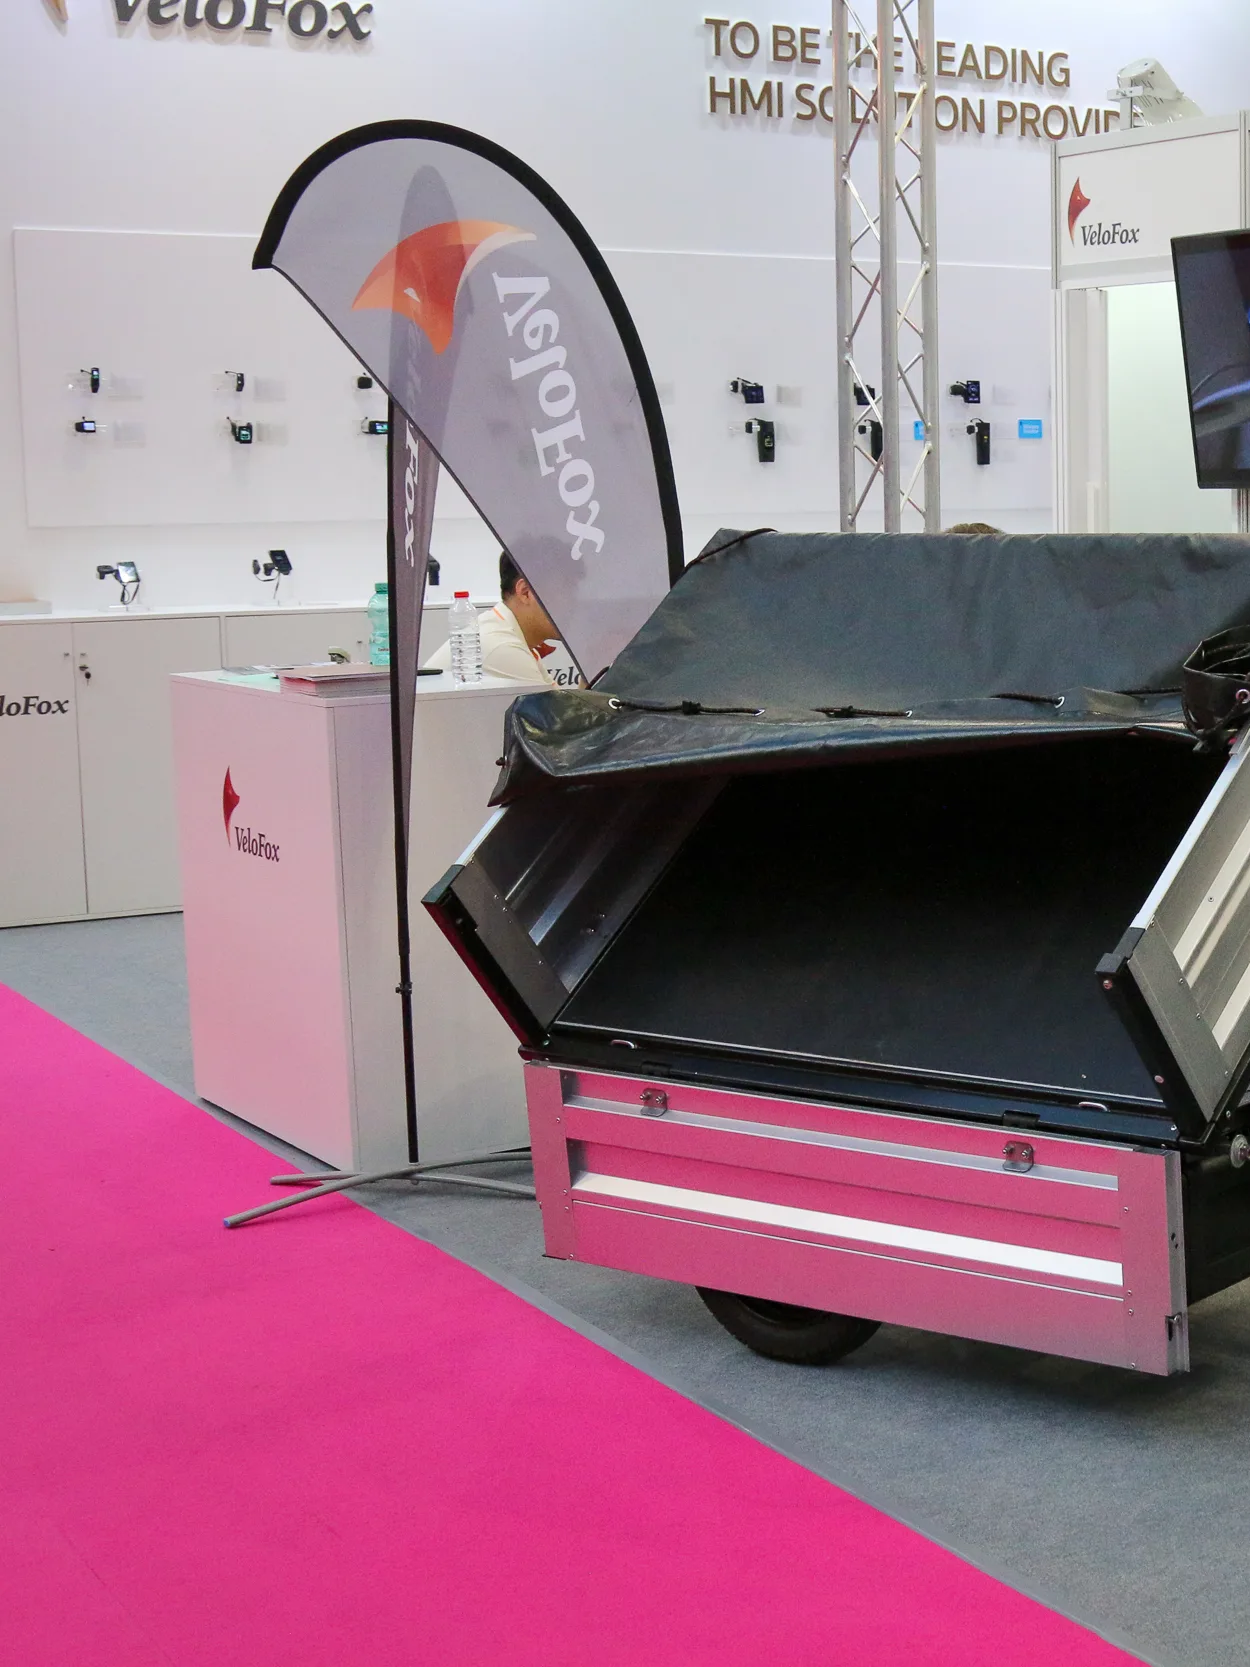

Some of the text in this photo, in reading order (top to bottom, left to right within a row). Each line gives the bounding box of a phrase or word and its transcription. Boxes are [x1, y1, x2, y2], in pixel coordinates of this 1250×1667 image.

[704, 17, 760, 59] TO
[772, 24, 821, 65] BE
[829, 30, 904, 72] HE
[708, 76, 784, 118] HMI
[795, 83, 986, 135] SLTON
[1081, 221, 1141, 247] VeloFox
[234, 826, 280, 862] VeloFox
